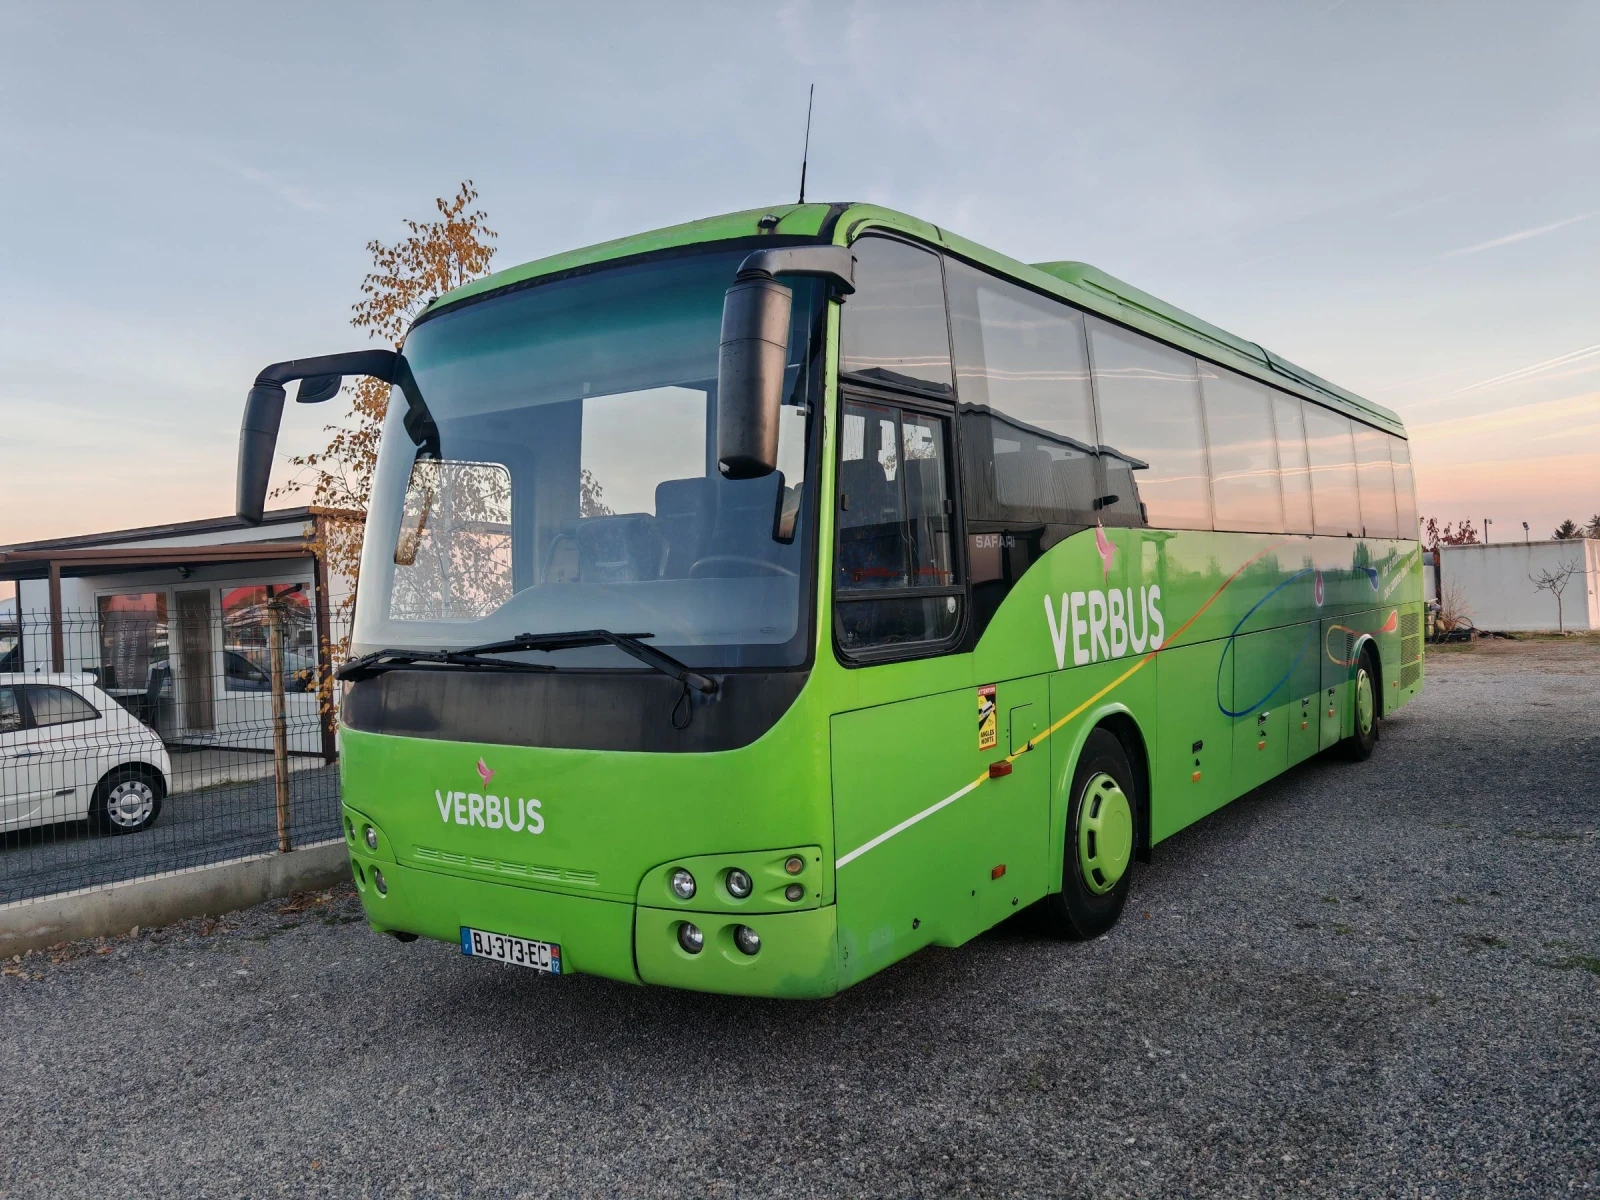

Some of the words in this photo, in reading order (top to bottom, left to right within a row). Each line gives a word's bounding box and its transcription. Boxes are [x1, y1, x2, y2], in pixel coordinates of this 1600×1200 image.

[975, 535, 1016, 548] SAFARI
[1044, 585, 1165, 670] VERBUS
[980, 729, 994, 738] ANGLES
[435, 789, 545, 835] VERBUS
[473, 932, 548, 967] BJ-373-EC
[552, 960, 560, 973] 12
